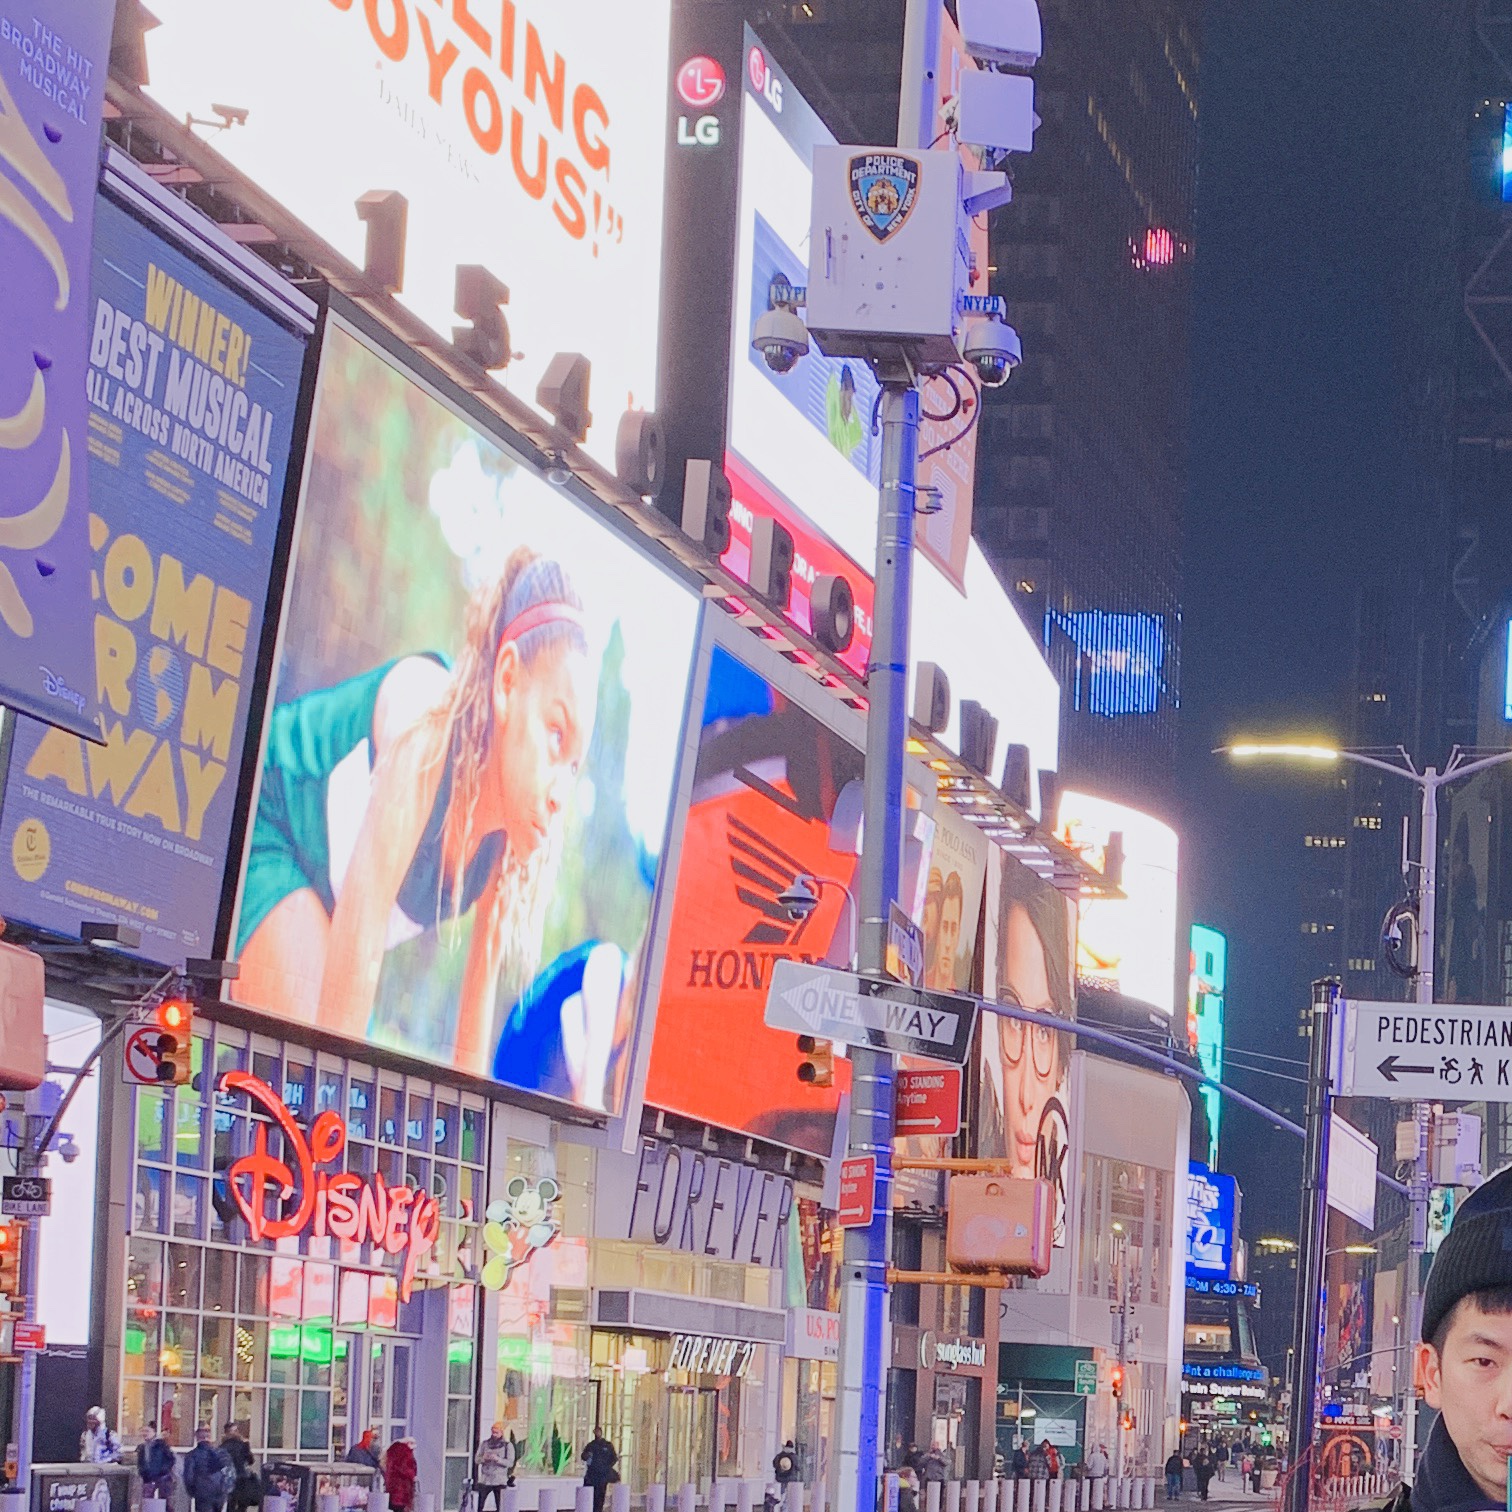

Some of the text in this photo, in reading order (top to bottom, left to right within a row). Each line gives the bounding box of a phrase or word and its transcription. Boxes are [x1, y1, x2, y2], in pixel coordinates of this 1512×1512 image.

[1, 19, 91, 100] BROADWAY
[32, 18, 93, 79] THE HIT
[20, 58, 87, 125] MUSICAL
[764, 66, 783, 114] LG
[678, 116, 720, 146] LG
[851, 165, 917, 183] DEPARTMENT
[865, 155, 904, 169] POLICE
[851, 190, 873, 228] CITY OF
[887, 188, 915, 232] NEW YORK
[145, 261, 252, 389] WINNER!
[963, 294, 1000, 312] NYPD
[89, 297, 165, 400] BEST
[164, 347, 273, 476] MUSICAL
[112, 386, 171, 446] ACROSS
[171, 422, 215, 474] NORTH
[213, 450, 269, 509] AMERICA
[89, 512, 253, 679] OME
[24, 710, 228, 841] AWAY
[22, 785, 215, 867] THE REMARKABLE TRUE STORY NOW ON BROADWAY
[801, 987, 946, 1039] ONE WAY
[910, 1075, 945, 1089] STANDING
[627, 1135, 794, 1267] FOREVER
[1213, 1282, 1237, 1294] 4:30
[806, 1315, 825, 1337] U.S.
[667, 1333, 757, 1377] FOREVER 21
[936, 1338, 986, 1371] sunglass hut
